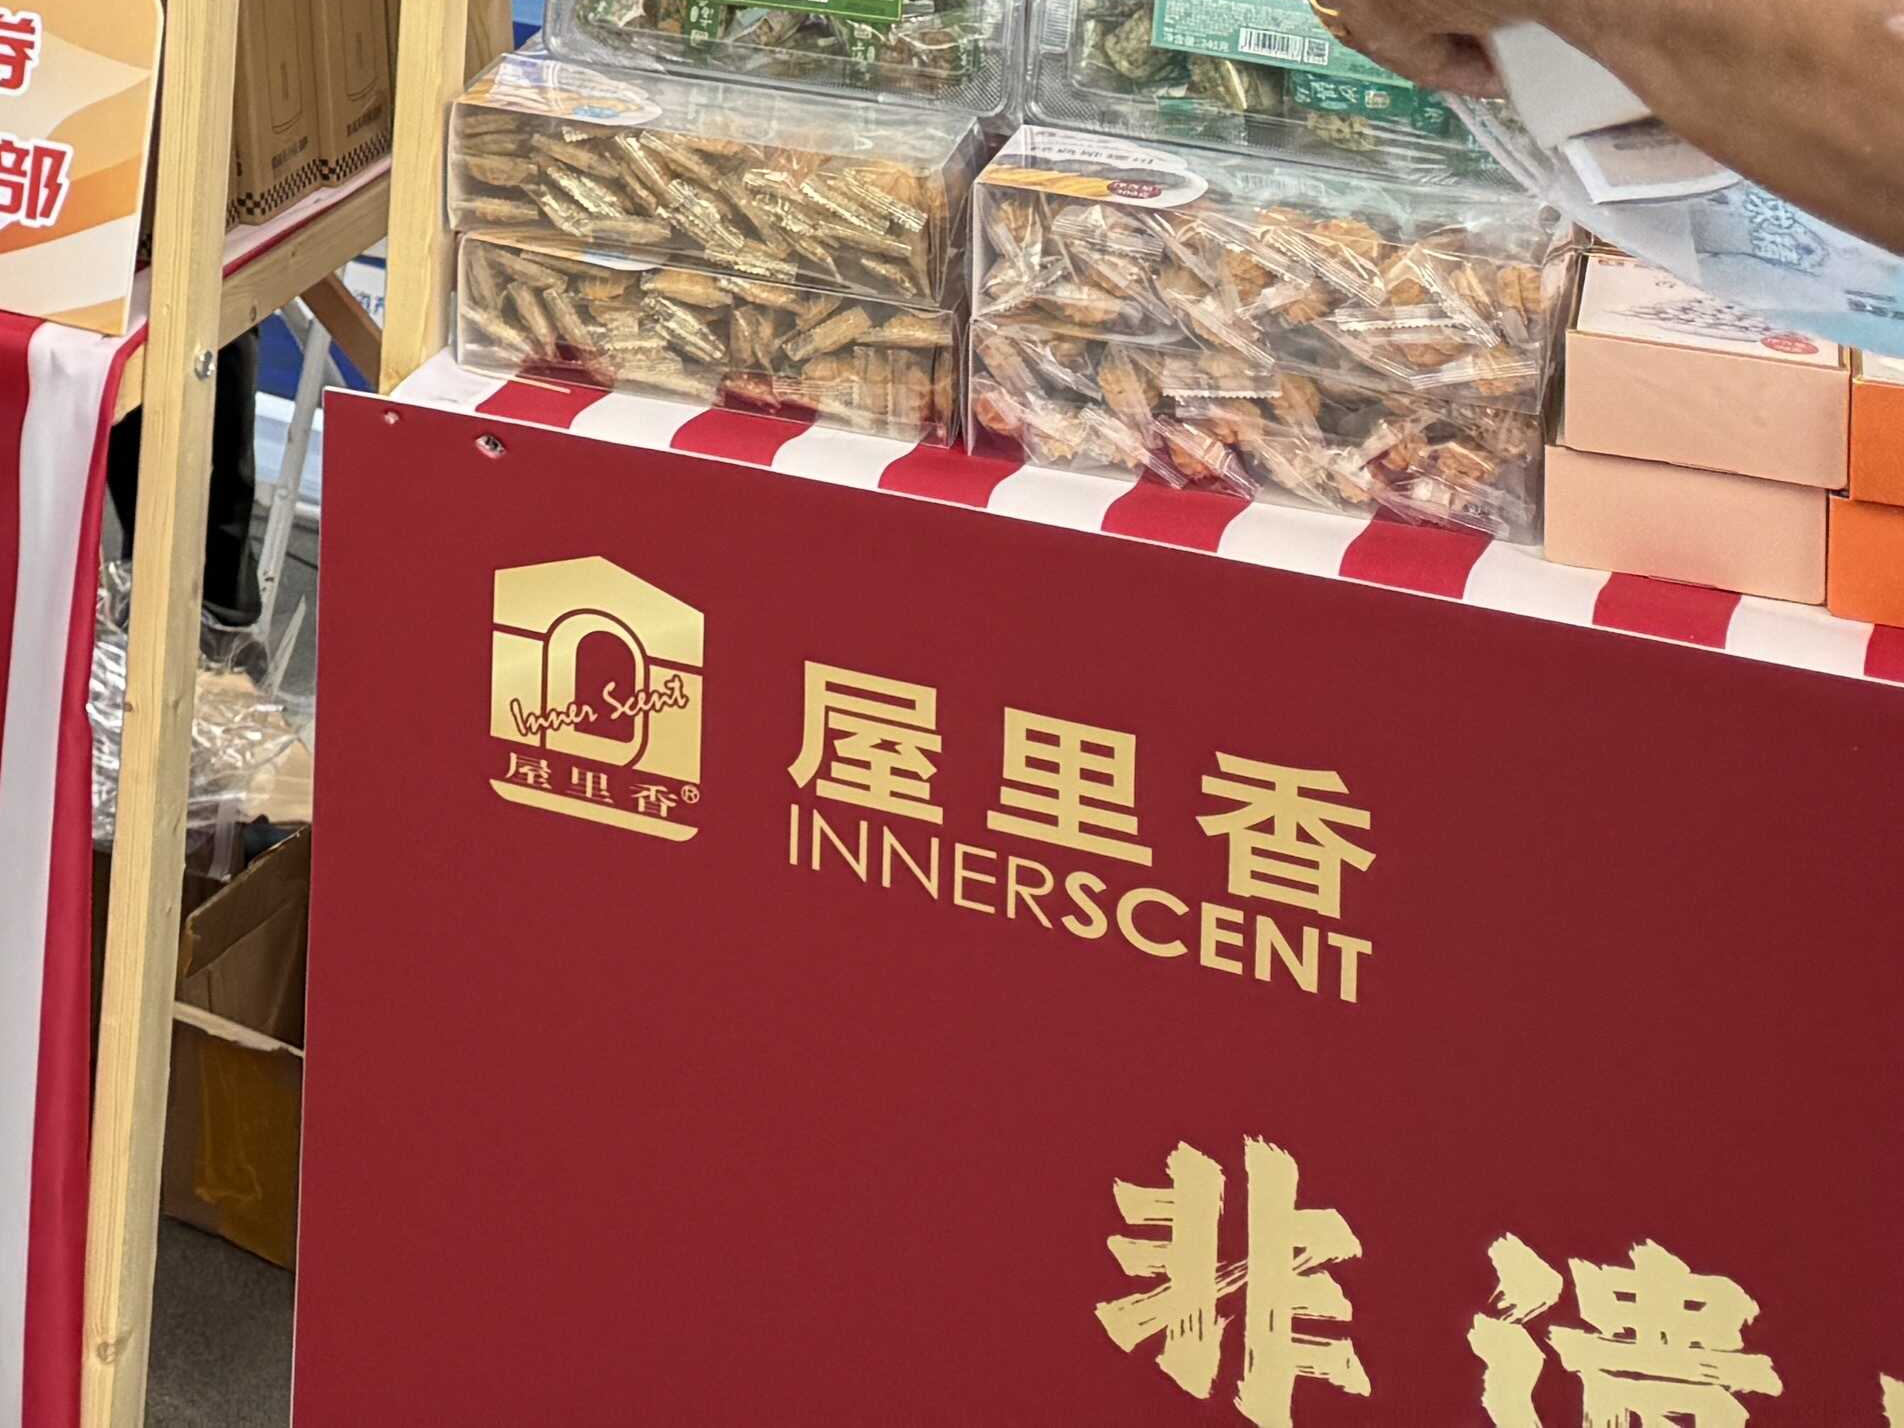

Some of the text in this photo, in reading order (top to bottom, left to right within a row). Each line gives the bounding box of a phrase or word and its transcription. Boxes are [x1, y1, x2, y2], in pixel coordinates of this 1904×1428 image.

[510, 674, 689, 737] Inner Scent
[788, 659, 1377, 922] 屋里香
[788, 803, 1373, 1004] INNERSCENT
[1094, 1135, 1904, 1428] 非遗
